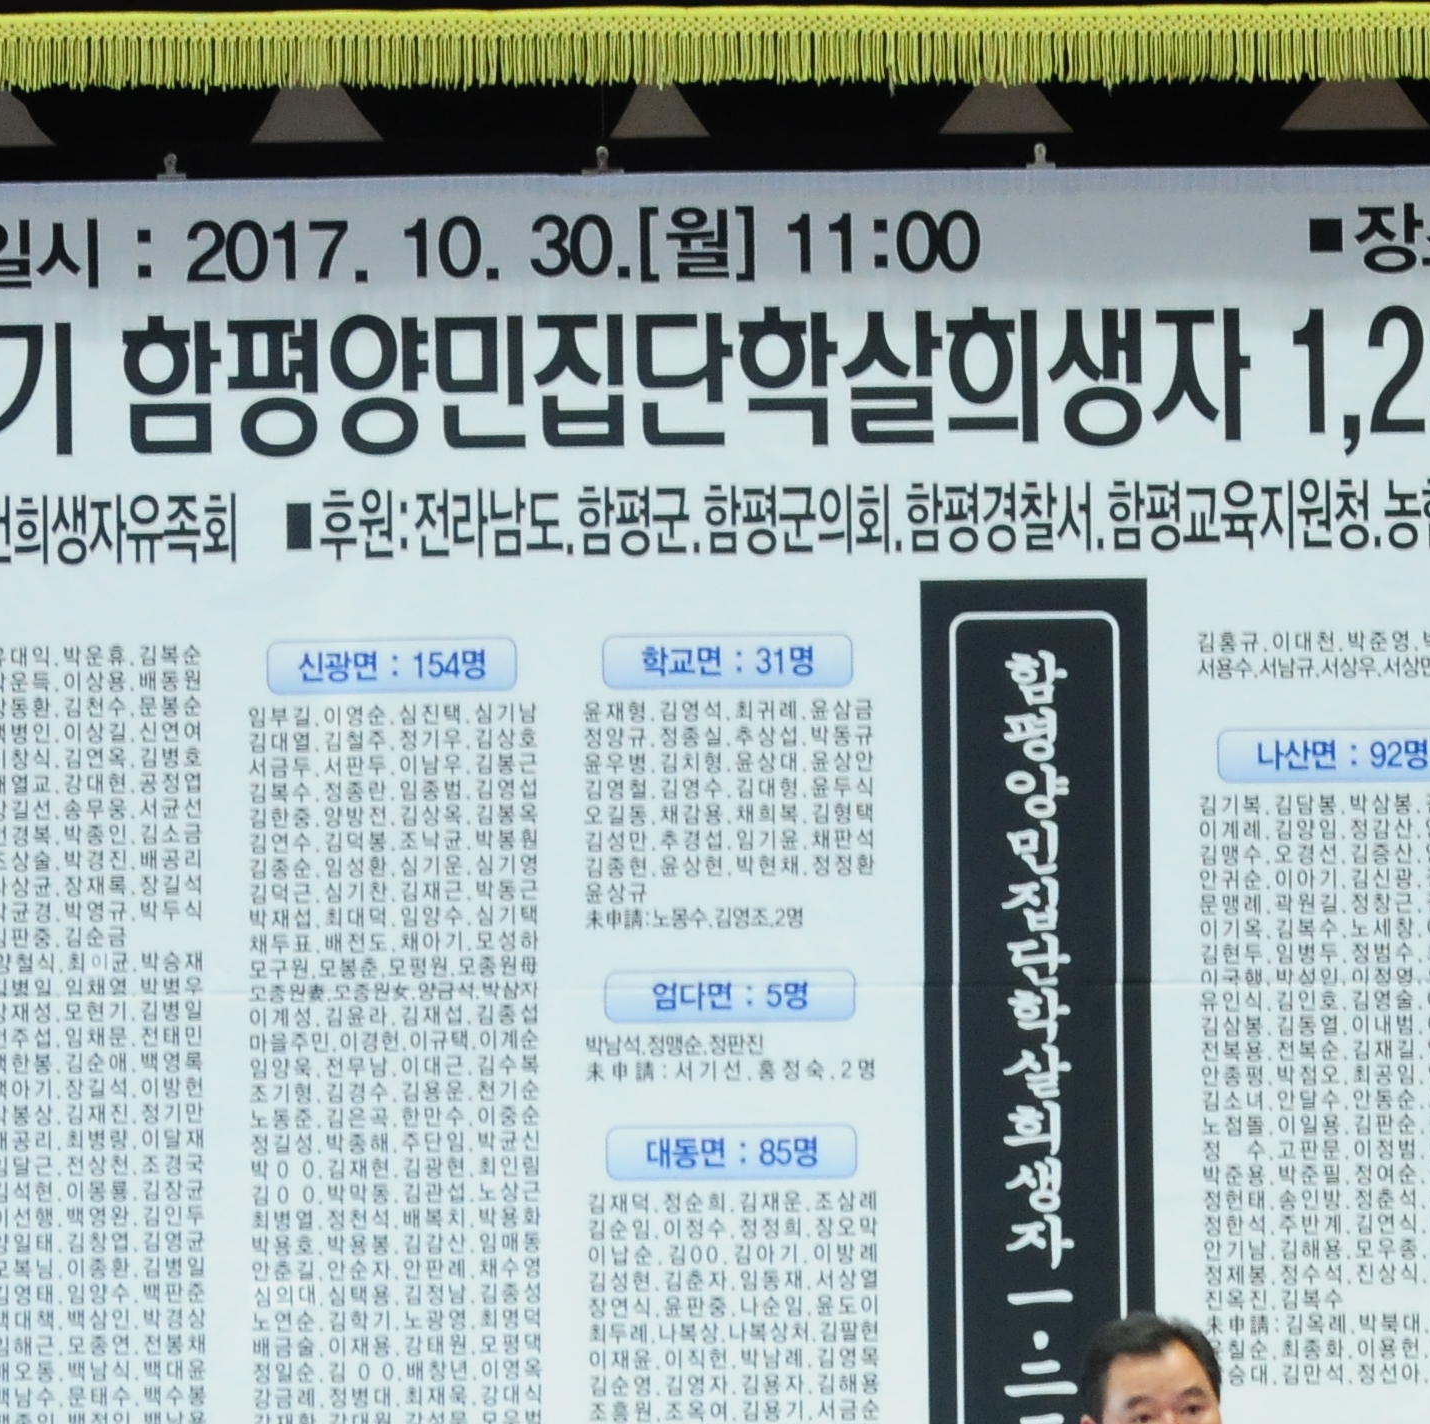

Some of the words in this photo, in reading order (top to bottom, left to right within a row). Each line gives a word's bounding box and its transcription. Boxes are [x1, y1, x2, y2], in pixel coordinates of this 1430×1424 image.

[187, 219, 368, 283] 2017.
[404, 215, 499, 281] 10.
[787, 209, 981, 274] 11:00
[122, 306, 1251, 458] 함평양민집단학살희생자
[298, 651, 377, 683] 신광면
[414, 649, 486, 680] 154명
[642, 646, 721, 677] 학교면
[756, 645, 814, 677] 31명
[1258, 740, 1336, 771] 나산면
[1370, 739, 1428, 770] 92명
[1001, 650, 1075, 1270] 함평양민집단학살희생자
[652, 982, 732, 1011] 엄다면
[767, 981, 808, 1010] 5명
[647, 1138, 725, 1169] 대동면
[759, 1136, 818, 1168] 85명
